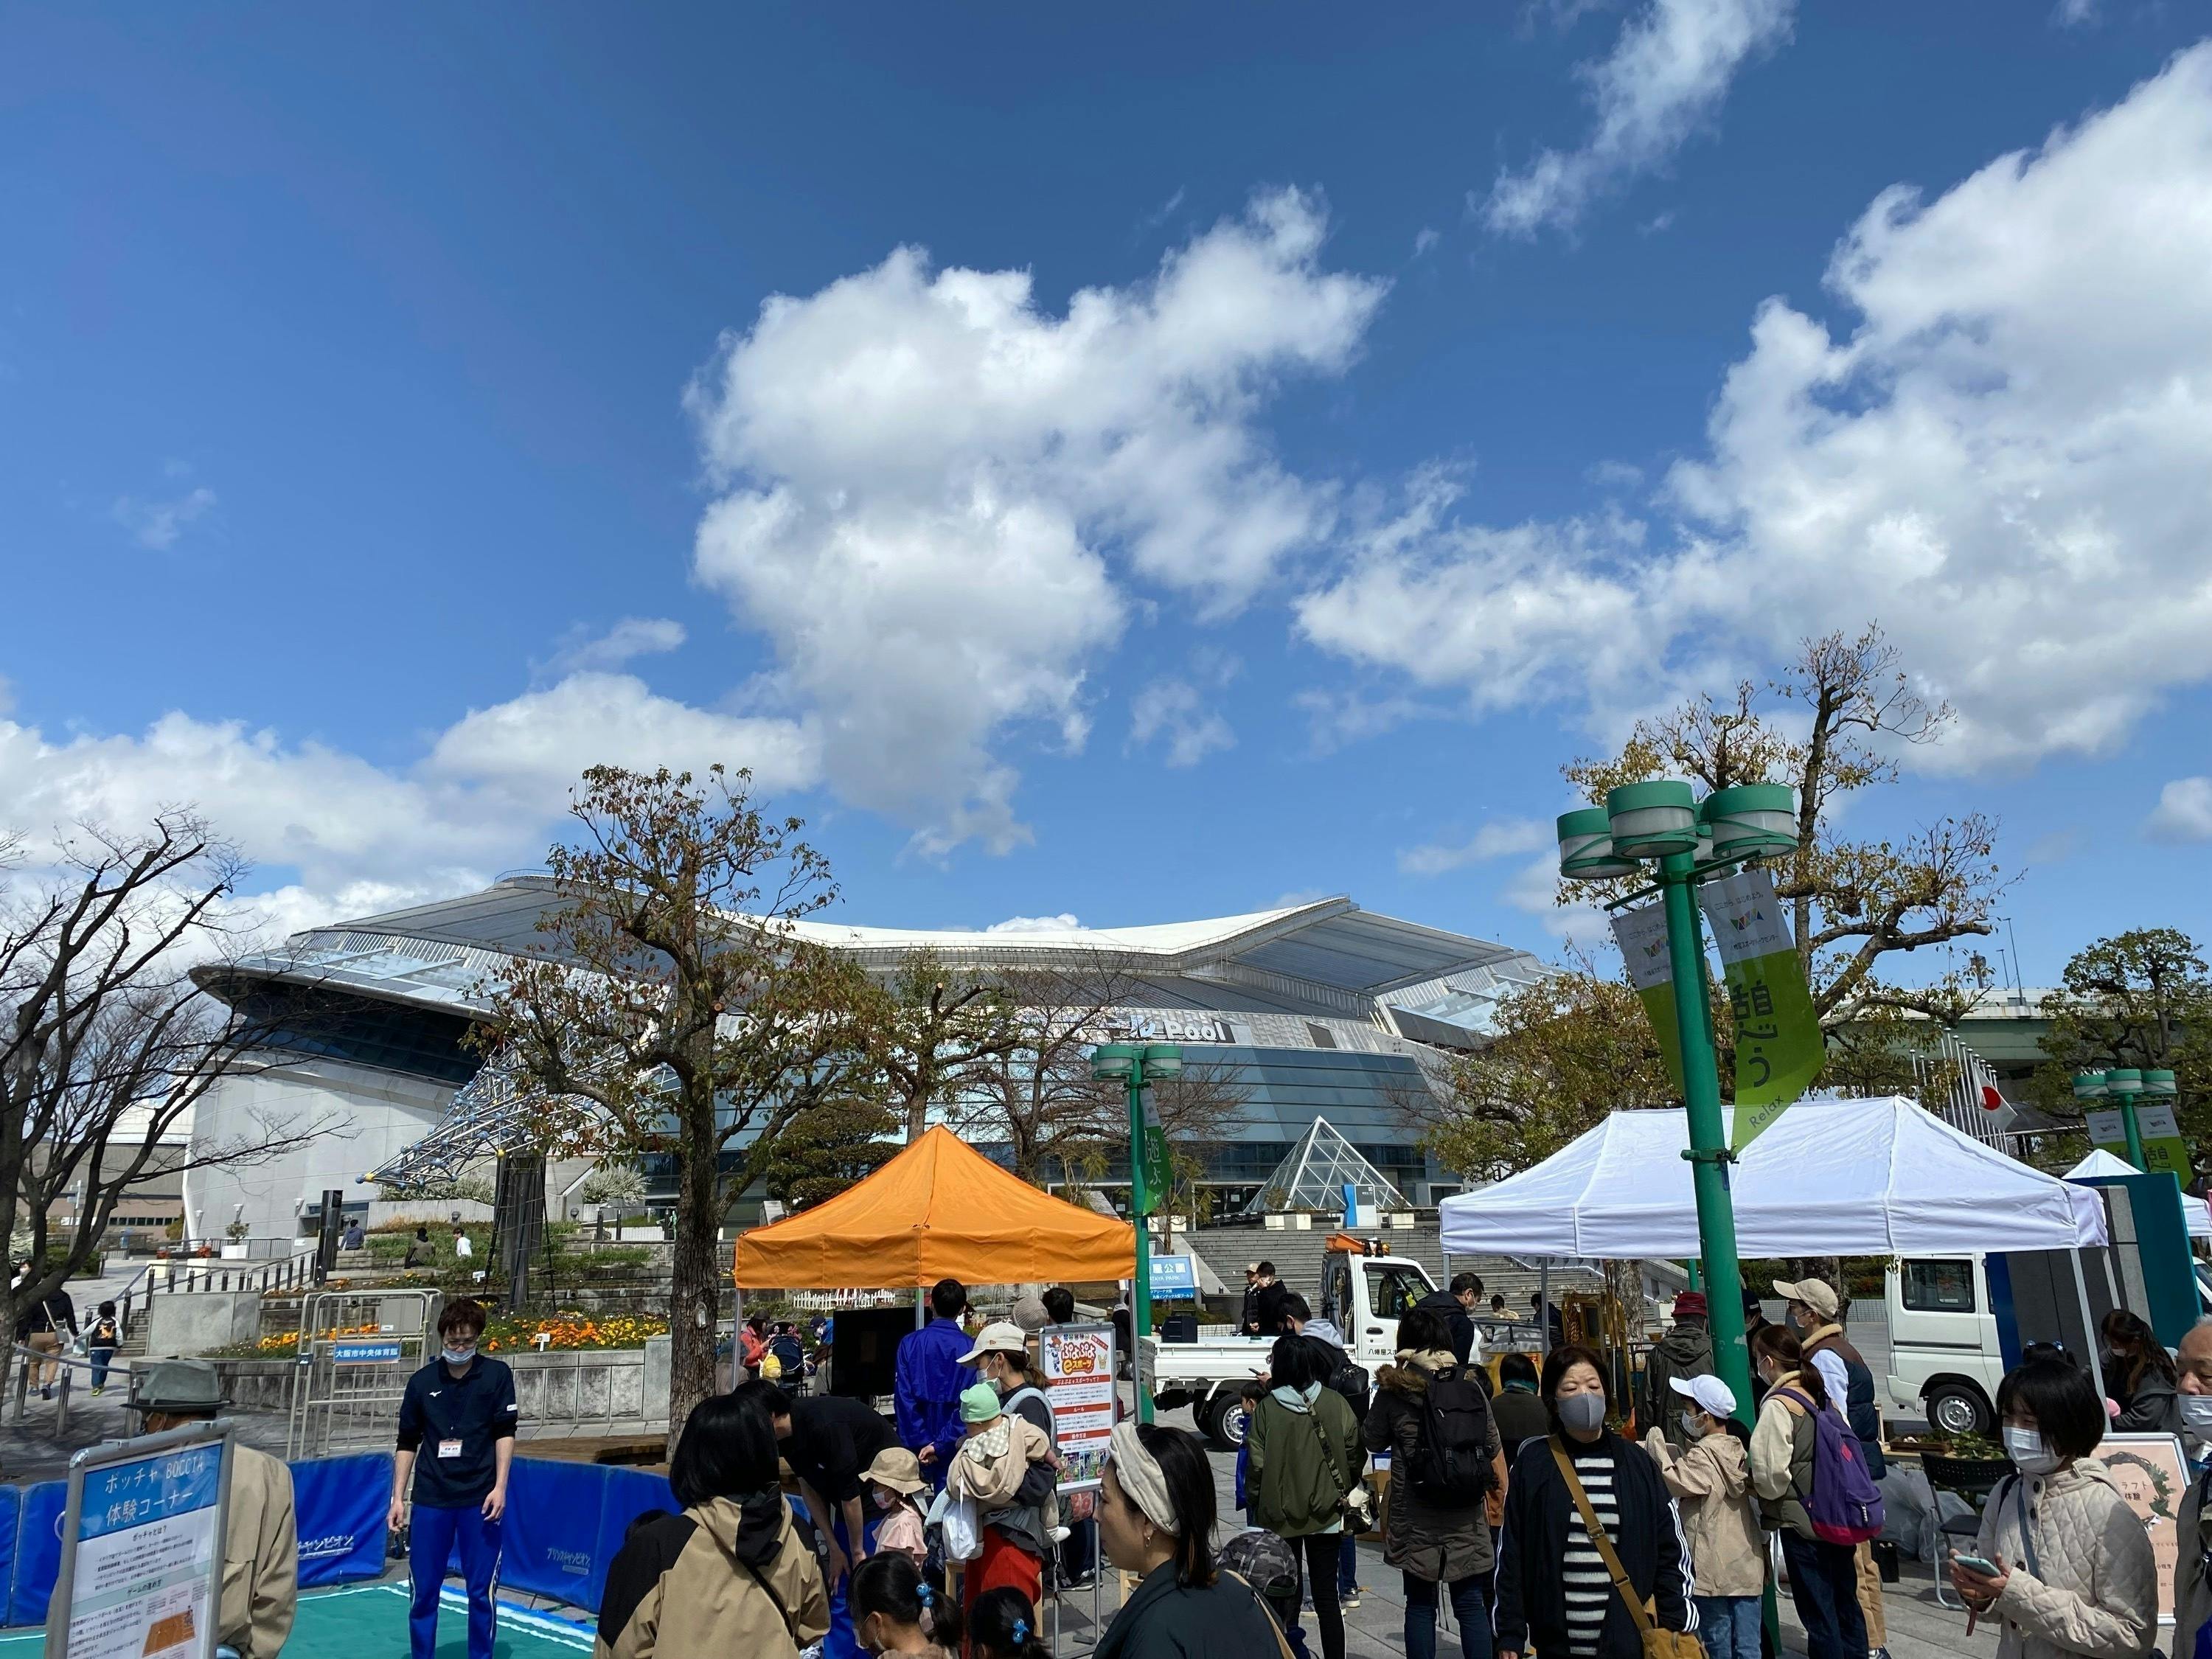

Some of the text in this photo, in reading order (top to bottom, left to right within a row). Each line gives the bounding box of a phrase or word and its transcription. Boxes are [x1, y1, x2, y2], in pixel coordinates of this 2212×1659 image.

[1164, 1020, 1226, 1040] Pool
[1733, 979, 1778, 1088] 憩う
[1749, 1095, 1784, 1128] Relax
[1146, 1135, 1161, 1186] 遊ぶ
[335, 1348, 398, 1358] 大阪市中央体育館
[1061, 1343, 1095, 1360] ぷよぷよ
[1063, 1359, 1092, 1374] eスポーツ
[105, 1455, 204, 1494] ボッチャ BOCCIA
[106, 1489, 193, 1527] 体験コーナー
